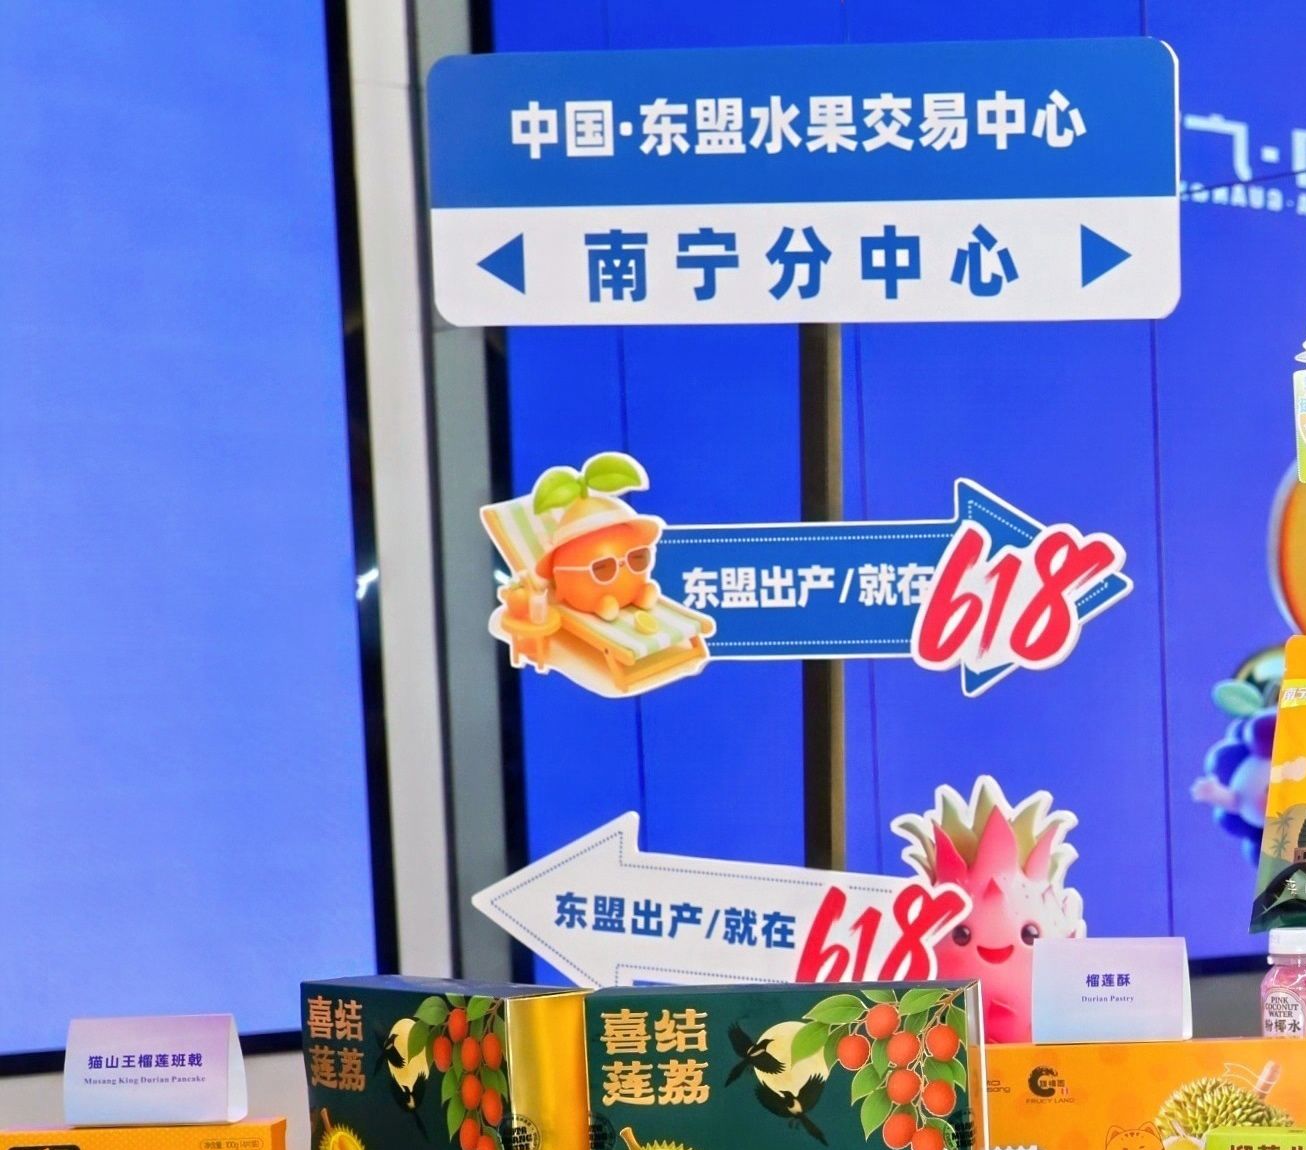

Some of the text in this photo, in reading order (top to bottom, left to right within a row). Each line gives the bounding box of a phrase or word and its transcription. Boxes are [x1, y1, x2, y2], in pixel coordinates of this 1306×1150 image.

[510, 89, 1087, 160] 中国·东盟水果交易中心
[584, 222, 1019, 303] 南宁分中心
[682, 526, 1116, 664] 东盟出产/就在 618
[554, 882, 968, 982] 东盟出产/就在 618
[1081, 995, 1135, 1004] Durian Pastry
[1086, 973, 1132, 988] 榴莲酥
[307, 995, 364, 1042] 喜结
[600, 1008, 709, 1055] 喜结
[88, 1052, 204, 1070] 猫山王榴莲班戟
[140, 1075, 206, 1084] Durian Pancake
[310, 1044, 366, 1092] 莲荔
[601, 1059, 710, 1108] 莲荔
